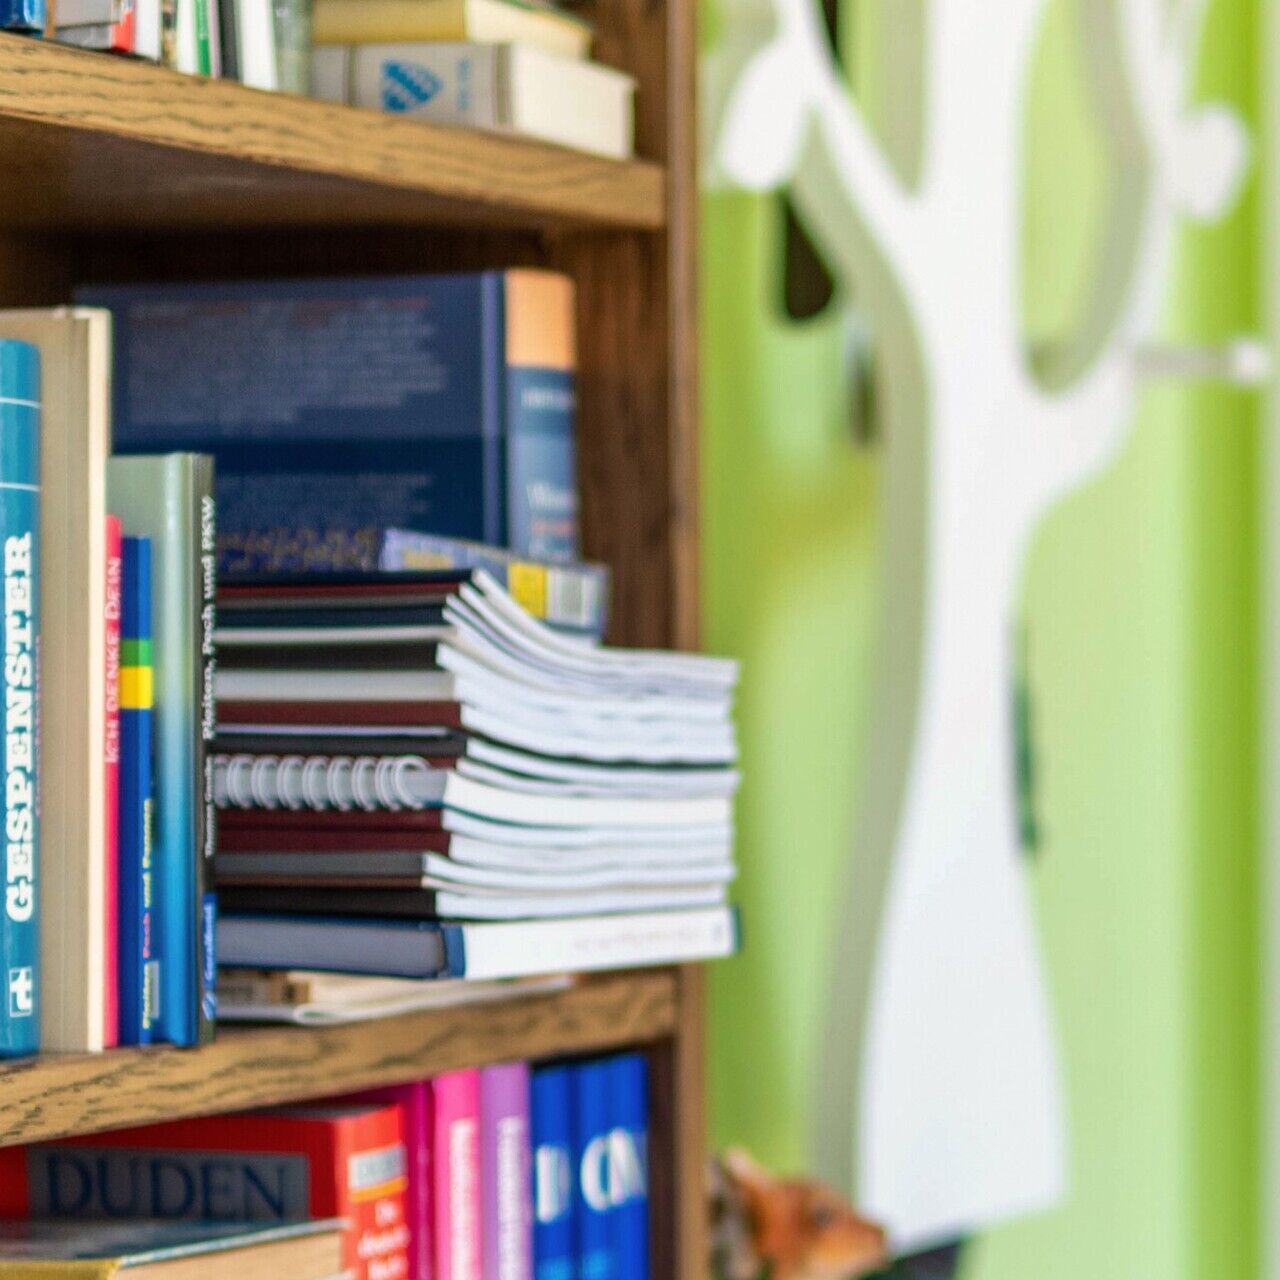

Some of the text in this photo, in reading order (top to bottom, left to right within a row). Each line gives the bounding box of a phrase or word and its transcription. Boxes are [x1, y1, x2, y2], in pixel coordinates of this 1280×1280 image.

[201, 556, 214, 599] und
[4, 532, 34, 922] GESPENSTER
[46, 1152, 287, 1217] DUDEN
